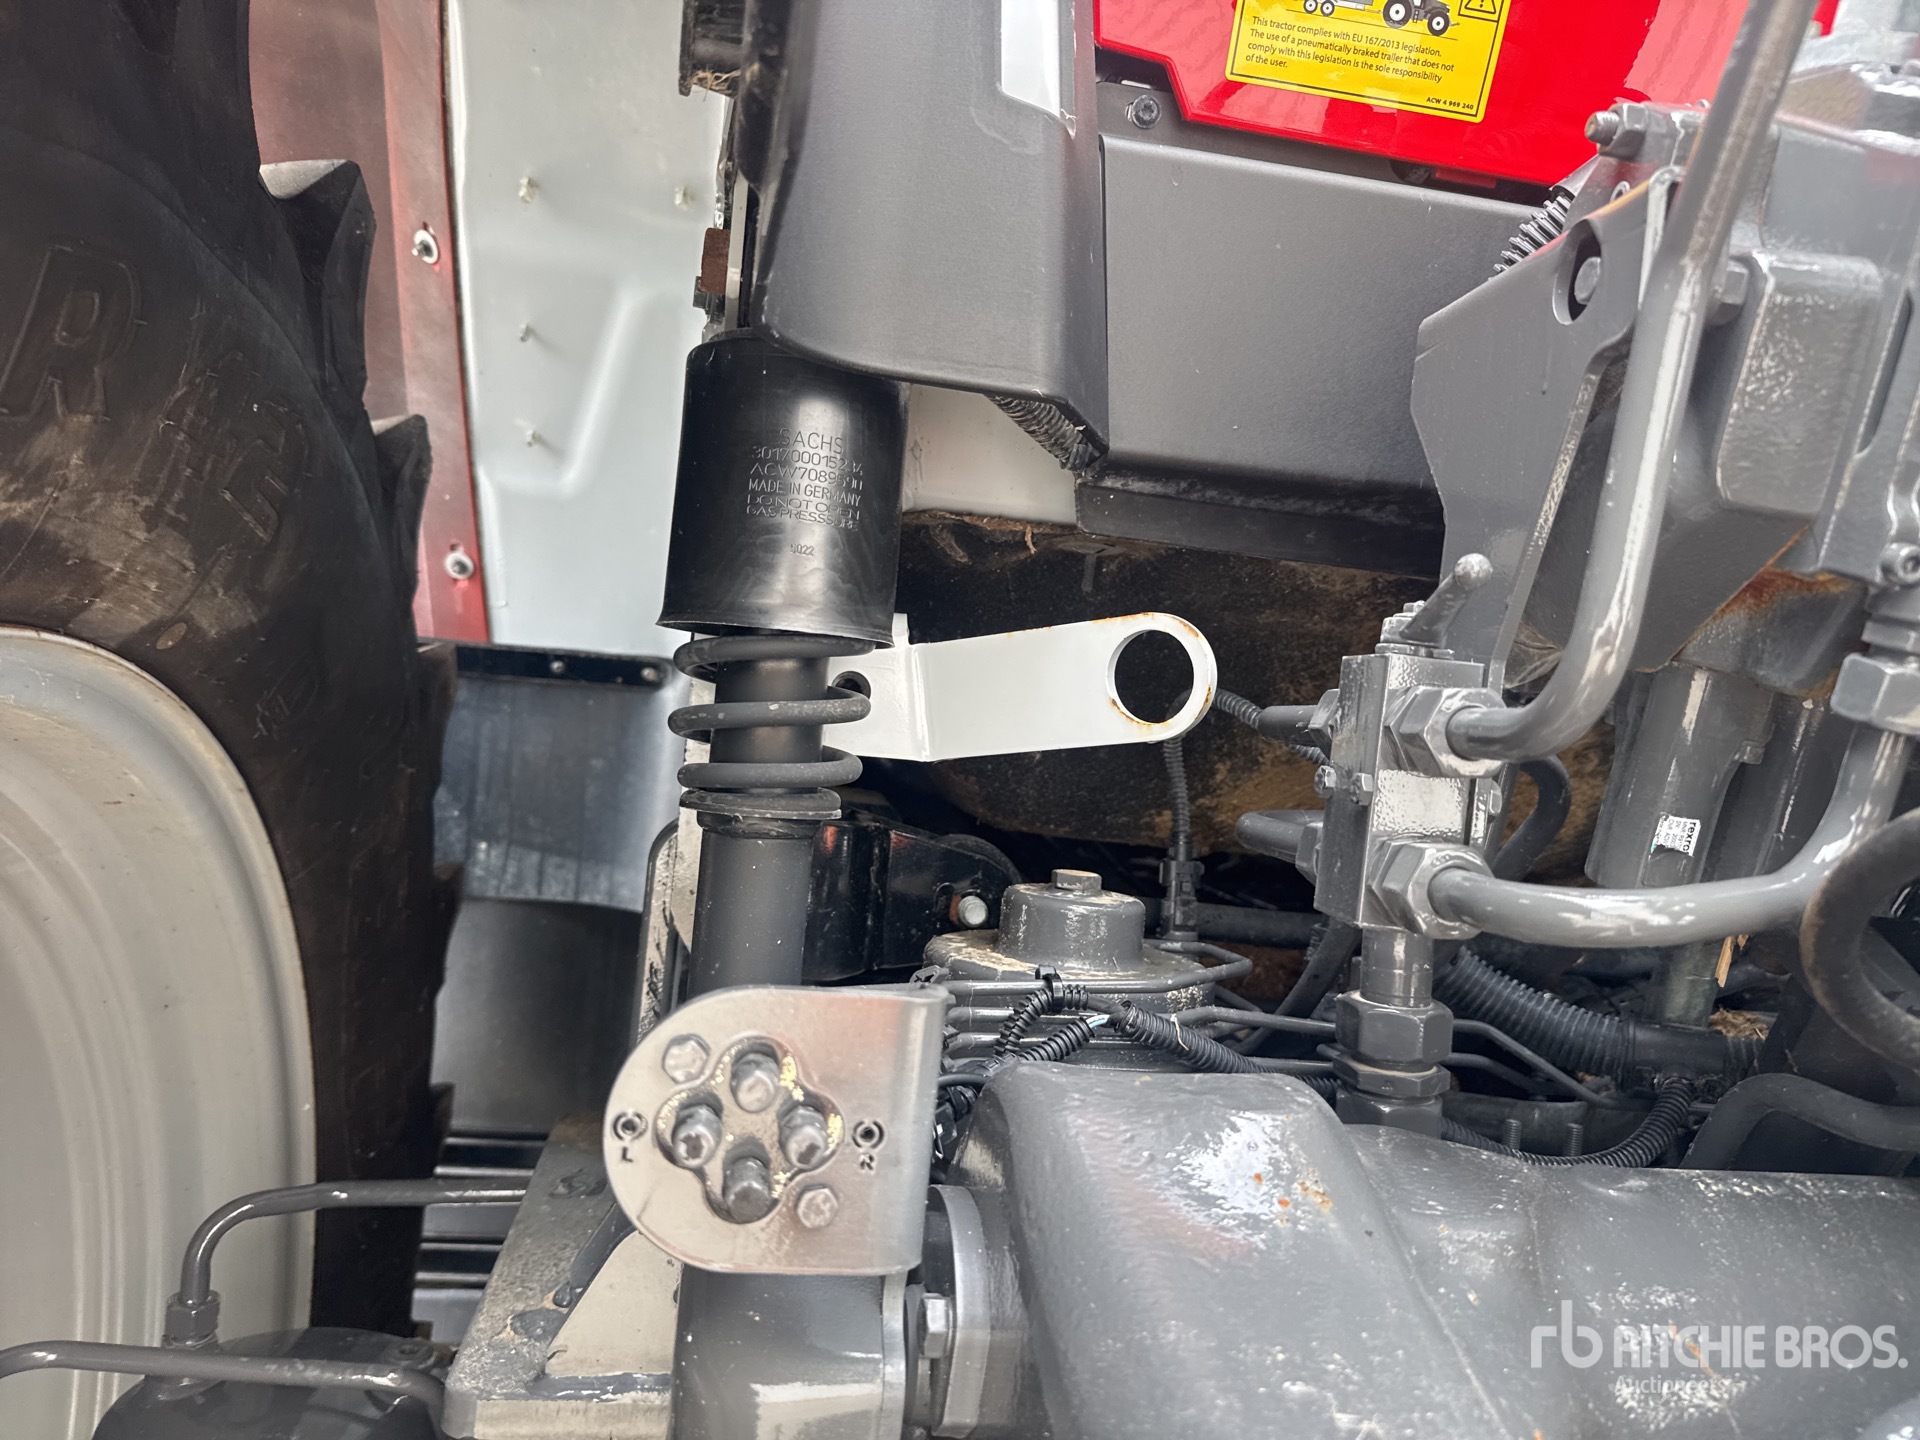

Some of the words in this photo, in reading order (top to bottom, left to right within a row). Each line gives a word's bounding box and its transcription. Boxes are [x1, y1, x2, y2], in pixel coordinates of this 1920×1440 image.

[1252, 16, 1268, 26] This
[1270, 19, 1296, 31] tractor
[1297, 25, 1332, 38] complies
[1334, 31, 1351, 41] with
[1352, 33, 1363, 42] EU
[1365, 36, 1400, 49] 167/2013
[1401, 42, 1442, 57] legislation.
[1245, 54, 1255, 62] of
[1255, 55, 1268, 65] the
[1270, 59, 1288, 68] user.
[1247, 42, 1277, 55] comply
[1278, 47, 1295, 57] with
[1297, 49, 1311, 60] this
[1312, 51, 1351, 66] legislation
[1353, 58, 1359, 67] is
[1361, 60, 1373, 70] the
[1375, 63, 1391, 73] sole
[1391, 68, 1443, 84] responsibility
[1250, 29, 1265, 38] The
[1266, 32, 1280, 41] use
[1281, 34, 1290, 43] of
[1297, 38, 1351, 55] pneumatically
[1353, 46, 1379, 59] braked
[1381, 51, 1403, 63] trailer
[1404, 56, 1420, 66] that
[1421, 59, 1439, 69] does
[1441, 63, 1455, 72] not
[1426, 97, 1441, 105] ACW
[779, 428, 845, 455] SACHS
[748, 478, 785, 494] MADE
[790, 483, 801, 496] IN
[804, 484, 861, 507] GERMANY
[746, 505, 777, 518] GAS
[747, 494, 773, 505] DO
[775, 498, 813, 510] NOT
[815, 502, 860, 521] OPEN
[622, 1147, 634, 1163] L
